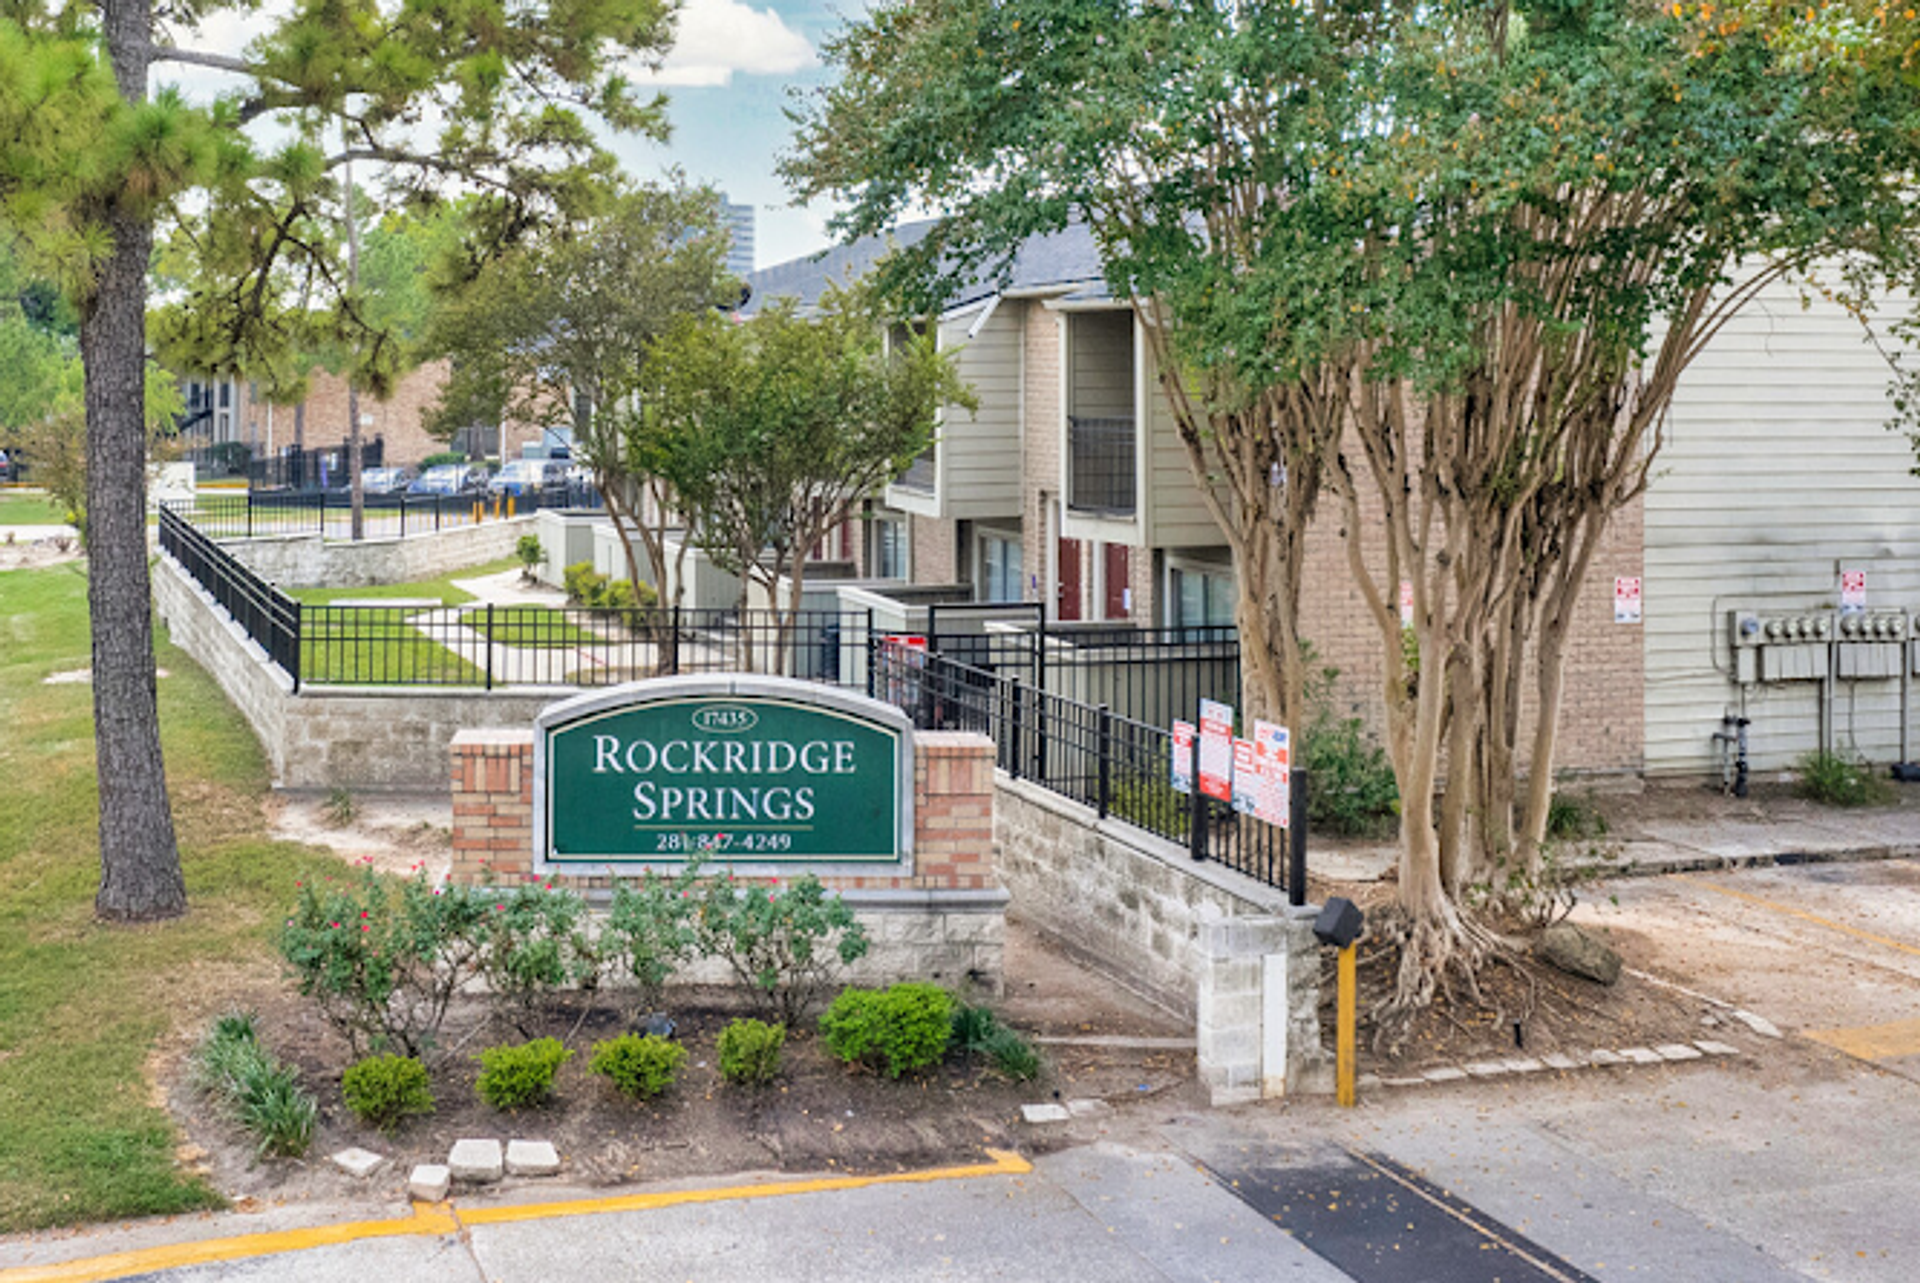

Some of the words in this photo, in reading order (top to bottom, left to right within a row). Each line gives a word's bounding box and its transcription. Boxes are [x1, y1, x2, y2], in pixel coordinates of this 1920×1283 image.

[703, 711, 748, 726] 17435
[592, 735, 856, 773] ROCKRIDGE
[633, 781, 815, 819] SPRINGS
